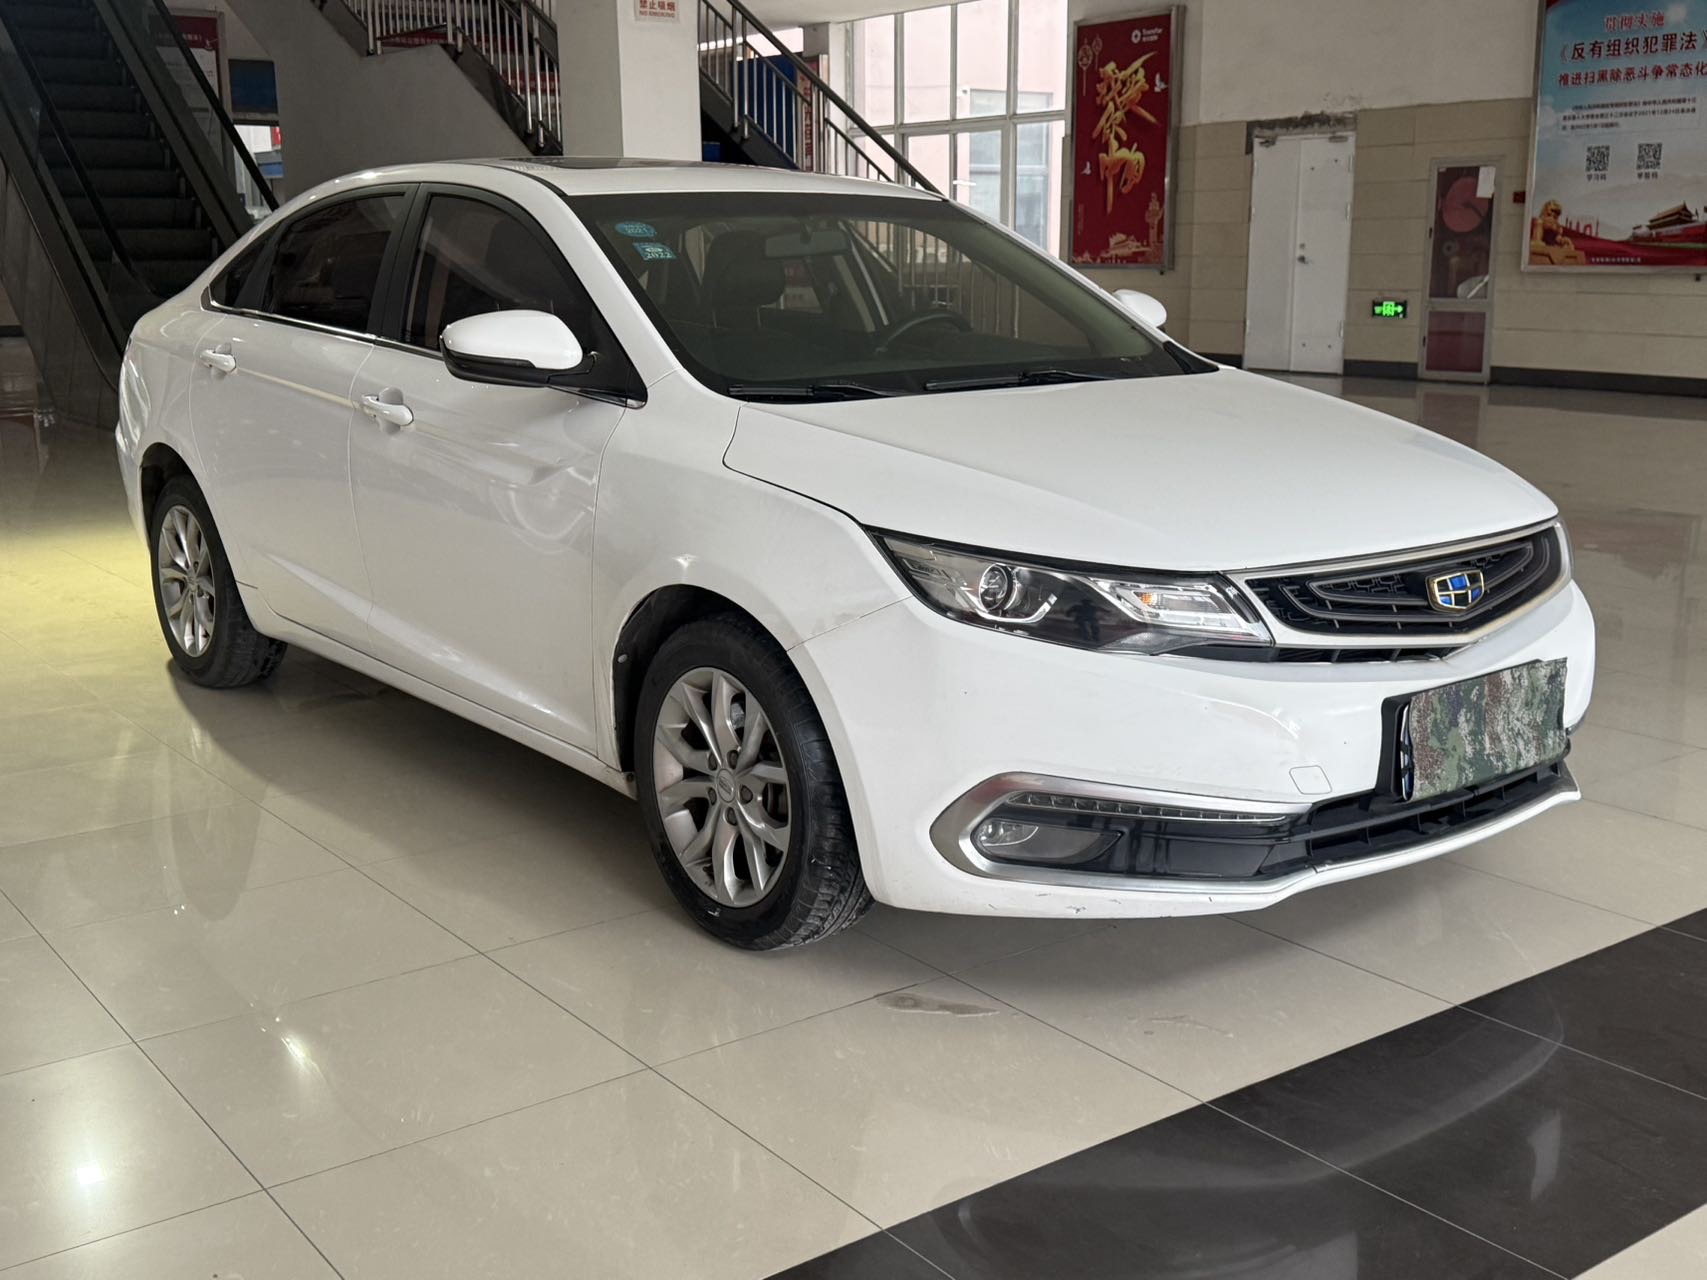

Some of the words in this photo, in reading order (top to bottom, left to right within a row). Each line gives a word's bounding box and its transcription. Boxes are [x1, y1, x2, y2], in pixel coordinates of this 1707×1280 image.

[1558, 60, 1707, 87] 推进扫黑除恶斗争常态化
